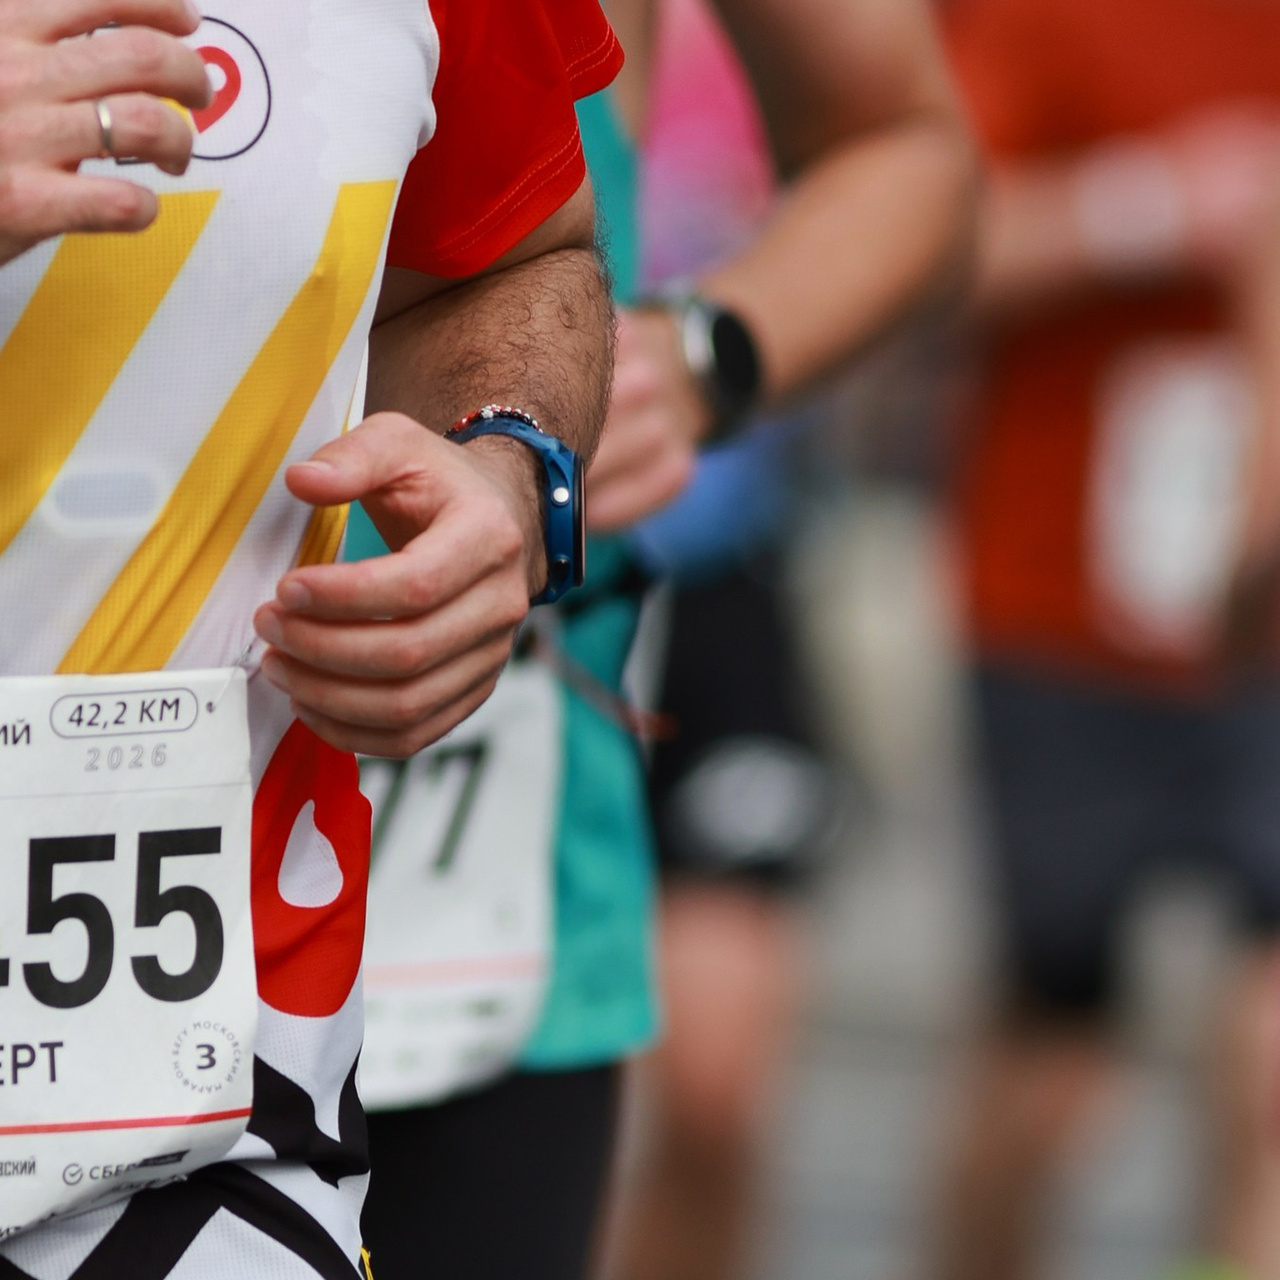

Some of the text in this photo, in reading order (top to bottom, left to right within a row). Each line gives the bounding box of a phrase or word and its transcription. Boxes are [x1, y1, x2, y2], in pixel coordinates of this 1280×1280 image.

[68, 702, 127, 730] 42,2
[84, 742, 167, 771] 2026
[195, 1044, 217, 1070] 3
